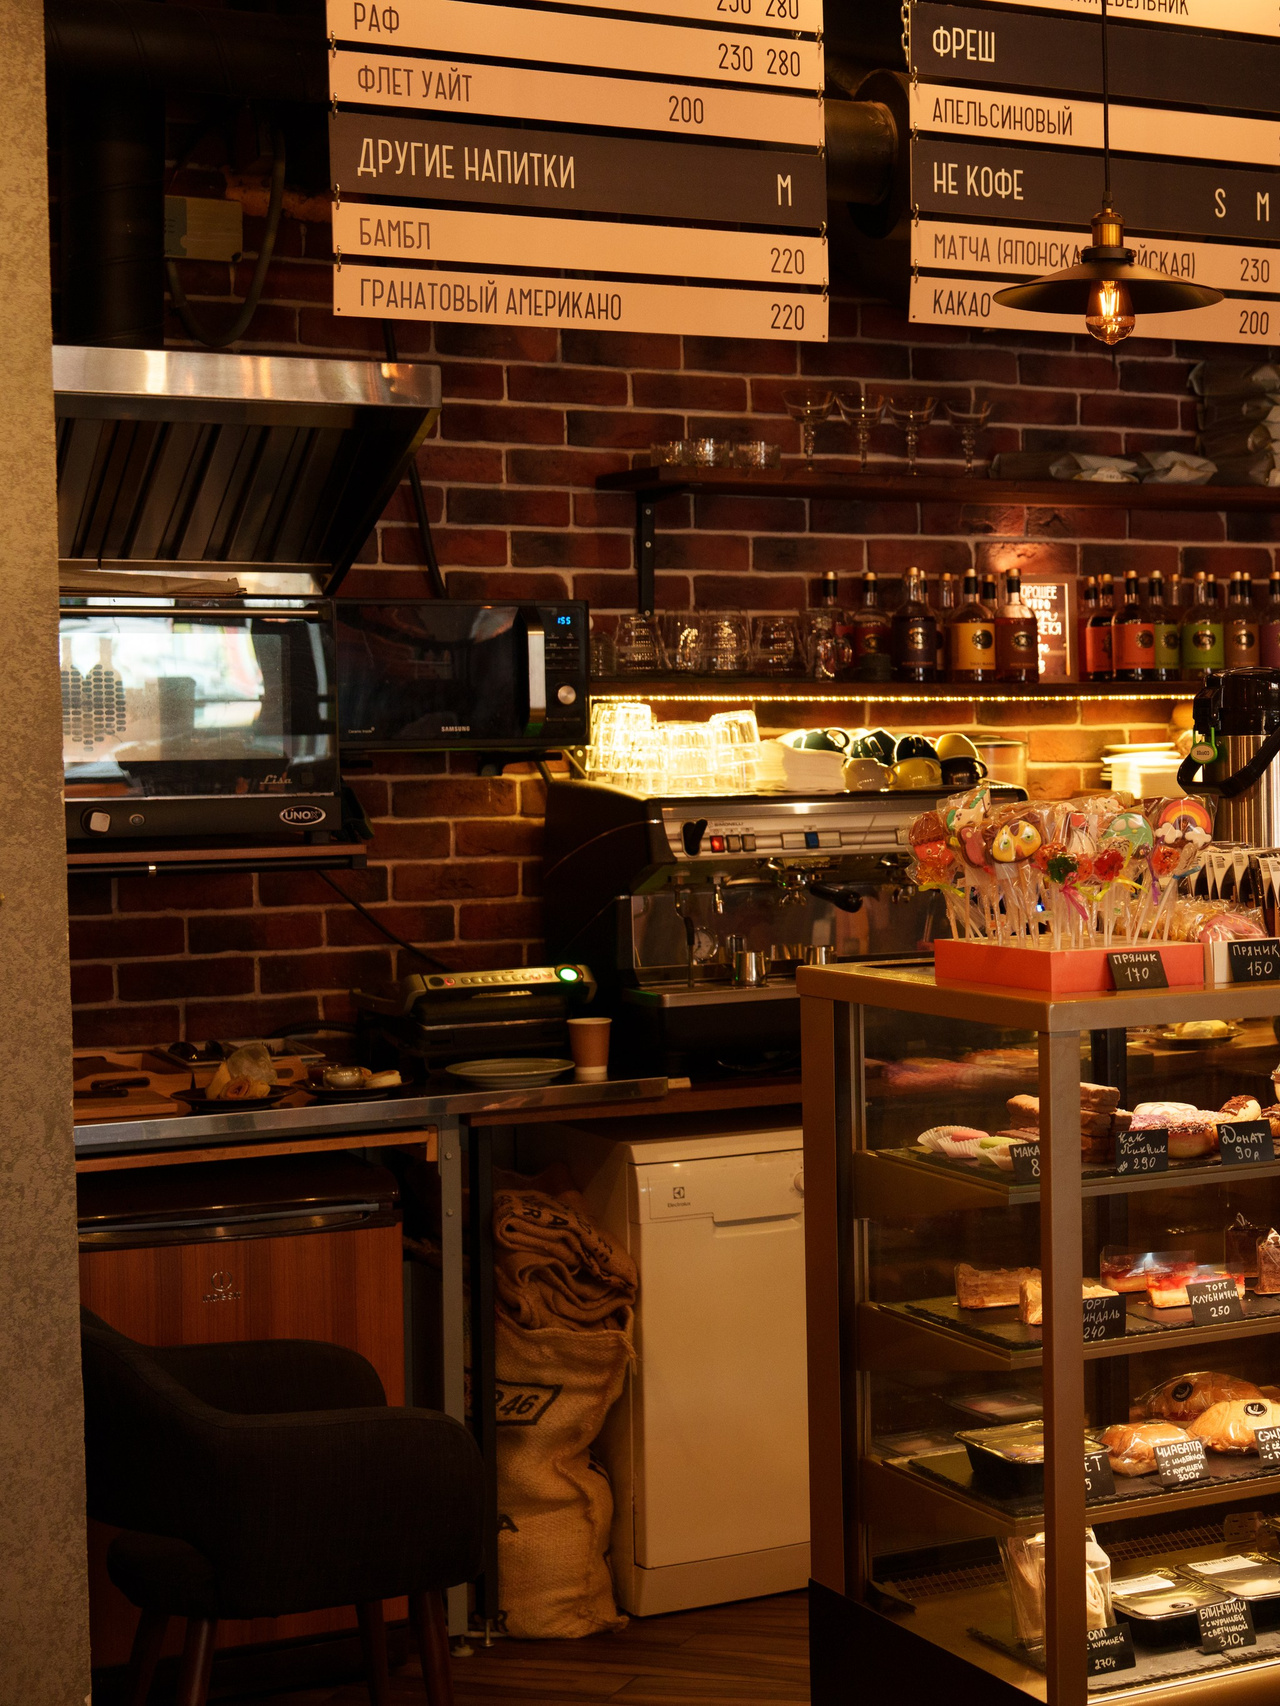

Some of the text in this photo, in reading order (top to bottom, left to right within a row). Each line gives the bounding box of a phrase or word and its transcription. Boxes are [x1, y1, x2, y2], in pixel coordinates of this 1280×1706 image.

[353, 3, 800, 77] РАФ 230 280
[932, 26, 995, 63] ФРЕШ
[358, 65, 704, 124] ФЛЕТ УАЙТ 200
[932, 97, 1073, 136] АПЕЛЬСИНОВЫЙ
[357, 138, 792, 206] ДРУГИЕ НАПИТКИ M
[933, 162, 958, 195] НЕ
[966, 165, 1024, 200] КОФЕ
[1214, 188, 1226, 218] S
[1257, 192, 1269, 222] M
[359, 217, 805, 275] БАМБЛ 220
[934, 233, 990, 263] МАТЧА
[1240, 258, 1270, 283] 230
[360, 279, 805, 331] ГРАНАТОВЫЙ АМЕРИКАНО 220
[933, 289, 991, 317] КАКАО
[1239, 310, 1269, 335] 200
[1113, 953, 1158, 965] ПРЯНИК
[1233, 944, 1280, 957] ПРЯНИК
[1125, 967, 1149, 982] 170
[1247, 961, 1273, 976] 150
[1133, 1157, 1157, 1170] 290
[1235, 1147, 1252, 1160] 90
[1205, 1282, 1228, 1291] ТОРТ
[1210, 1305, 1231, 1317] 250
[1083, 1326, 1106, 1339] 240
[1200, 1602, 1247, 1619] БЛИНЧИКИ
